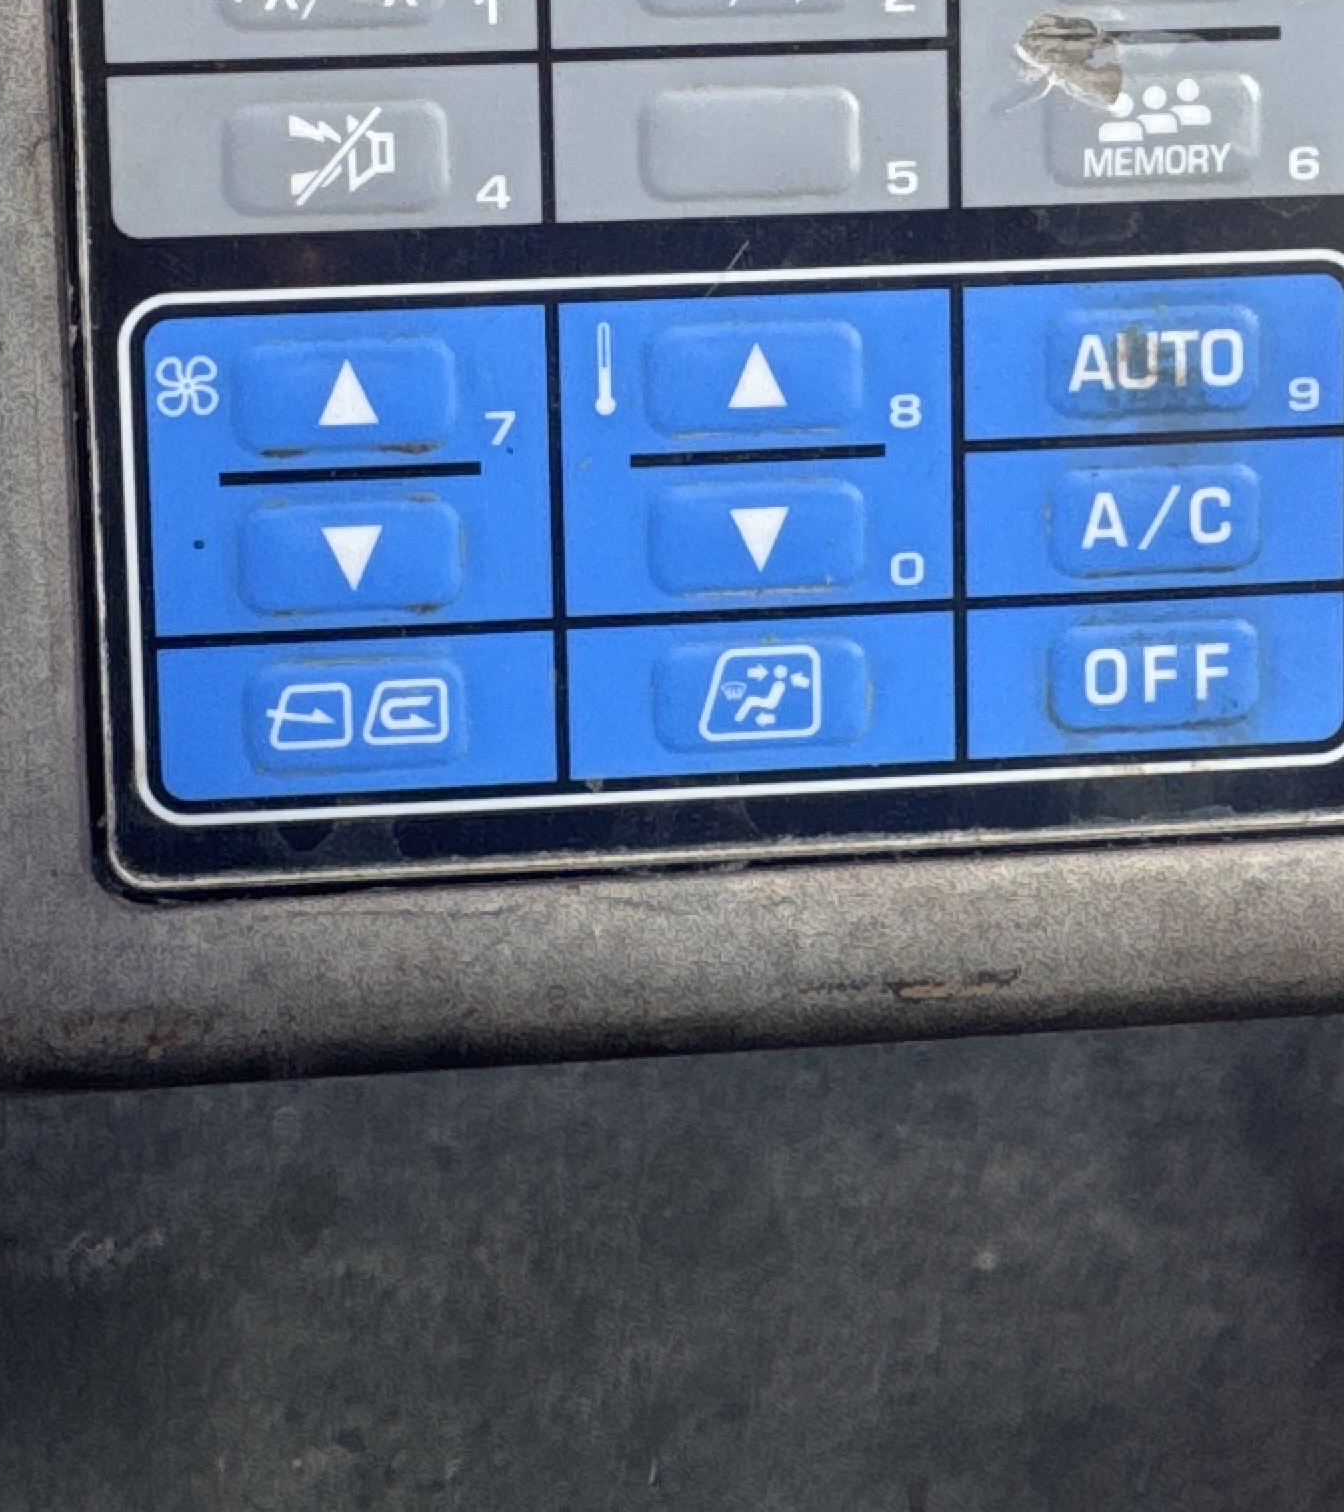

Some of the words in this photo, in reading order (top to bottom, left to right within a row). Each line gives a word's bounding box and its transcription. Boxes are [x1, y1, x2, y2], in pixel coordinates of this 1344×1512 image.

[886, 160, 918, 196] 5
[1084, 142, 1232, 178] MEMORY
[1288, 146, 1320, 180] 6
[476, 174, 512, 210] 4
[1068, 328, 1244, 392] AUTO
[890, 394, 922, 428] 8
[1288, 377, 1320, 412] 9
[486, 410, 516, 445] 7
[1082, 485, 1232, 550] A/C
[890, 552, 924, 586] 0
[1084, 642, 1230, 706] OFF
